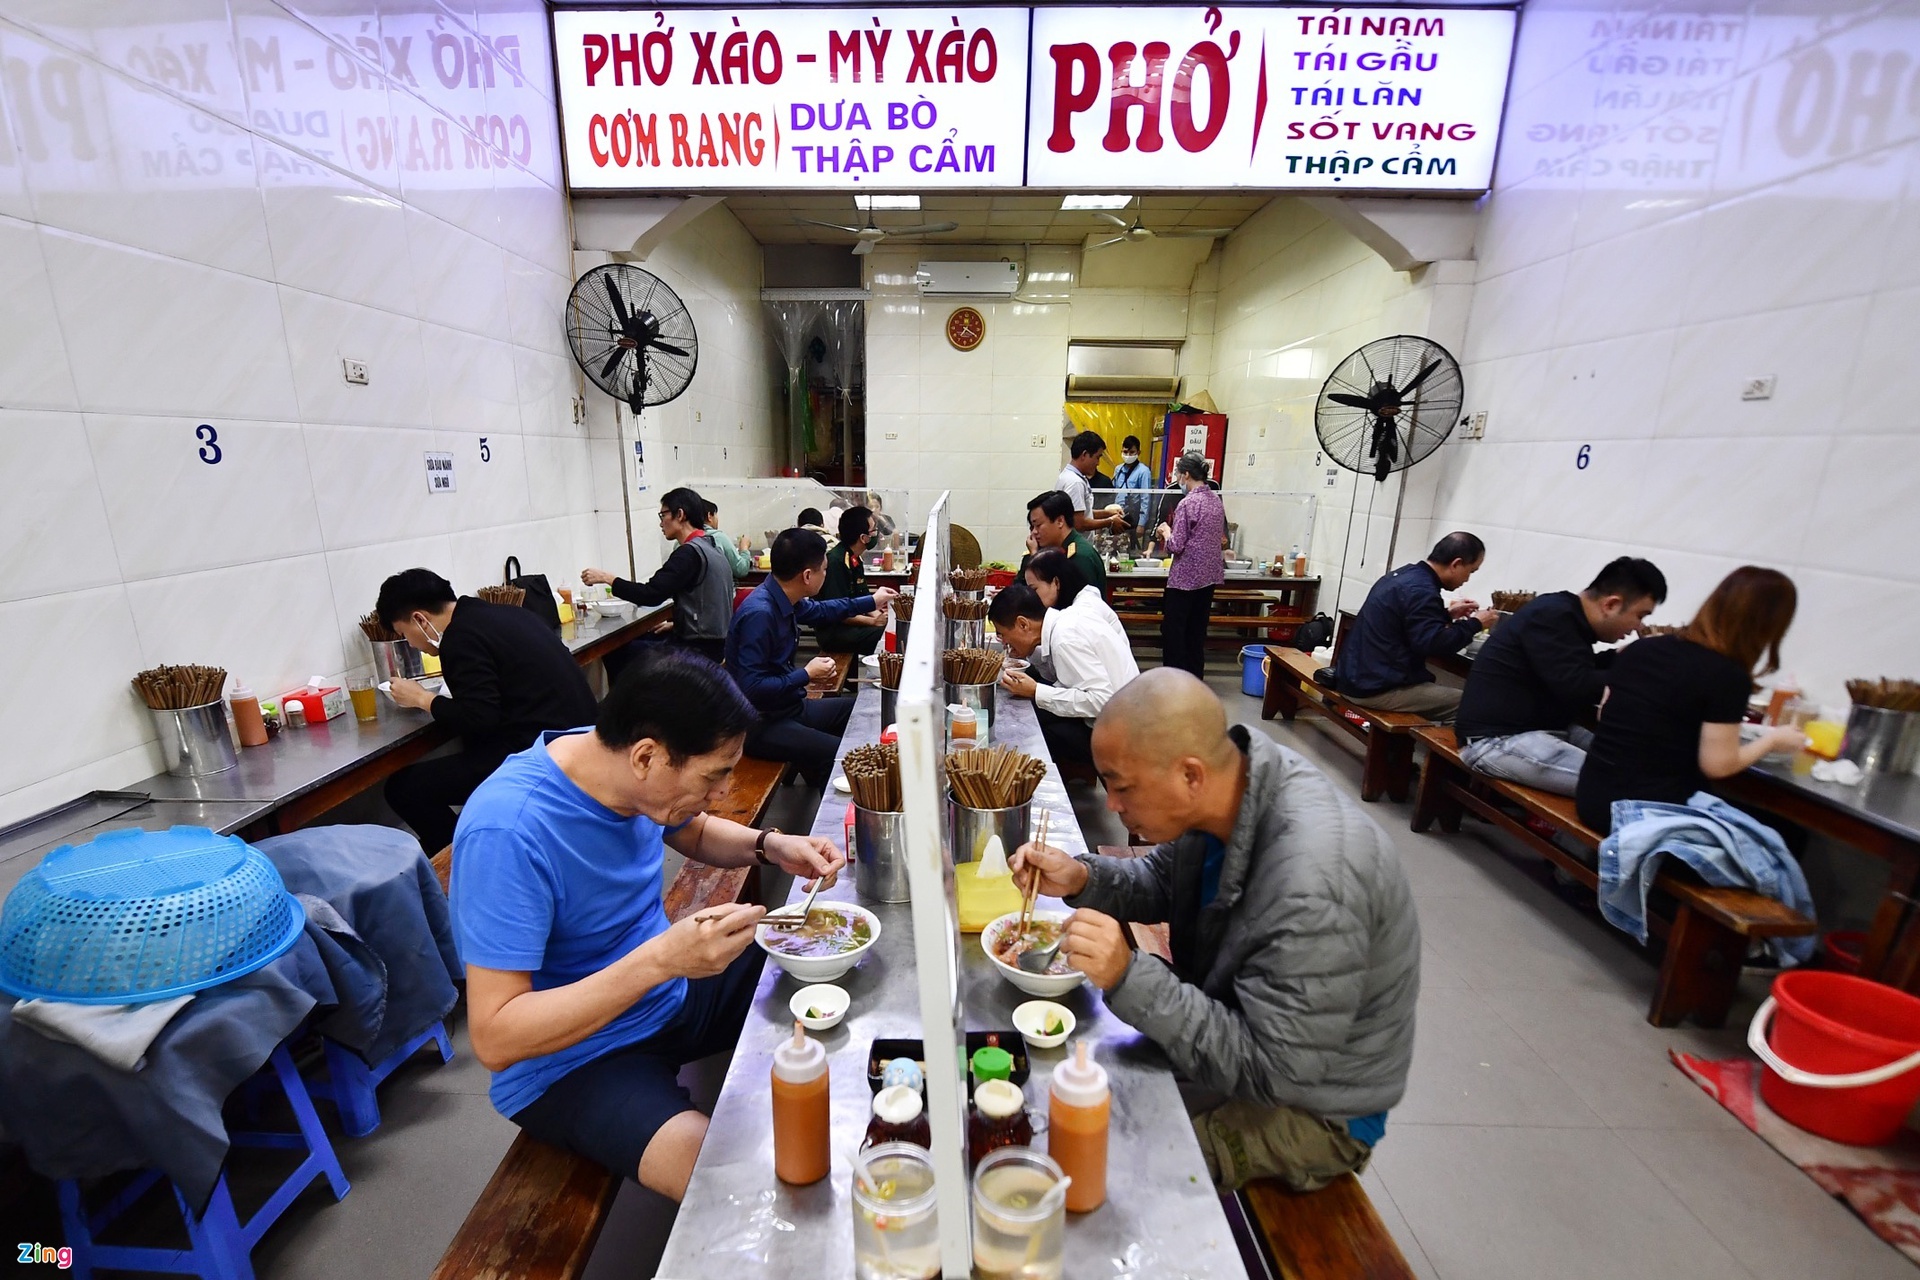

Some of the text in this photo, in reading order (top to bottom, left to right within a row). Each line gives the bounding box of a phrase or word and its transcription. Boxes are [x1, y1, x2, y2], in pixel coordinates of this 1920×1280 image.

[1297, 8, 1351, 36] TÁI
[583, 12, 675, 86] PHỞ
[690, 16, 783, 86] XÀO
[829, 17, 893, 83] MỲ
[906, 16, 998, 83] XÀO
[1294, 39, 1438, 71] TÁI GẦU
[1046, 8, 1241, 154] PHỞ
[1290, 79, 1422, 106] TÁI LĂN
[791, 94, 938, 131] DƯA BÒ
[1287, 110, 1477, 142] SỐT VANG
[589, 107, 767, 168] CƠM RANG
[792, 127, 996, 182] THẬP CẨM
[1286, 143, 1456, 182] THẬP CẨM
[196, 424, 223, 465] 3
[479, 437, 491, 463] 5
[1315, 451, 1322, 467] 8
[1577, 444, 1591, 470] 6
